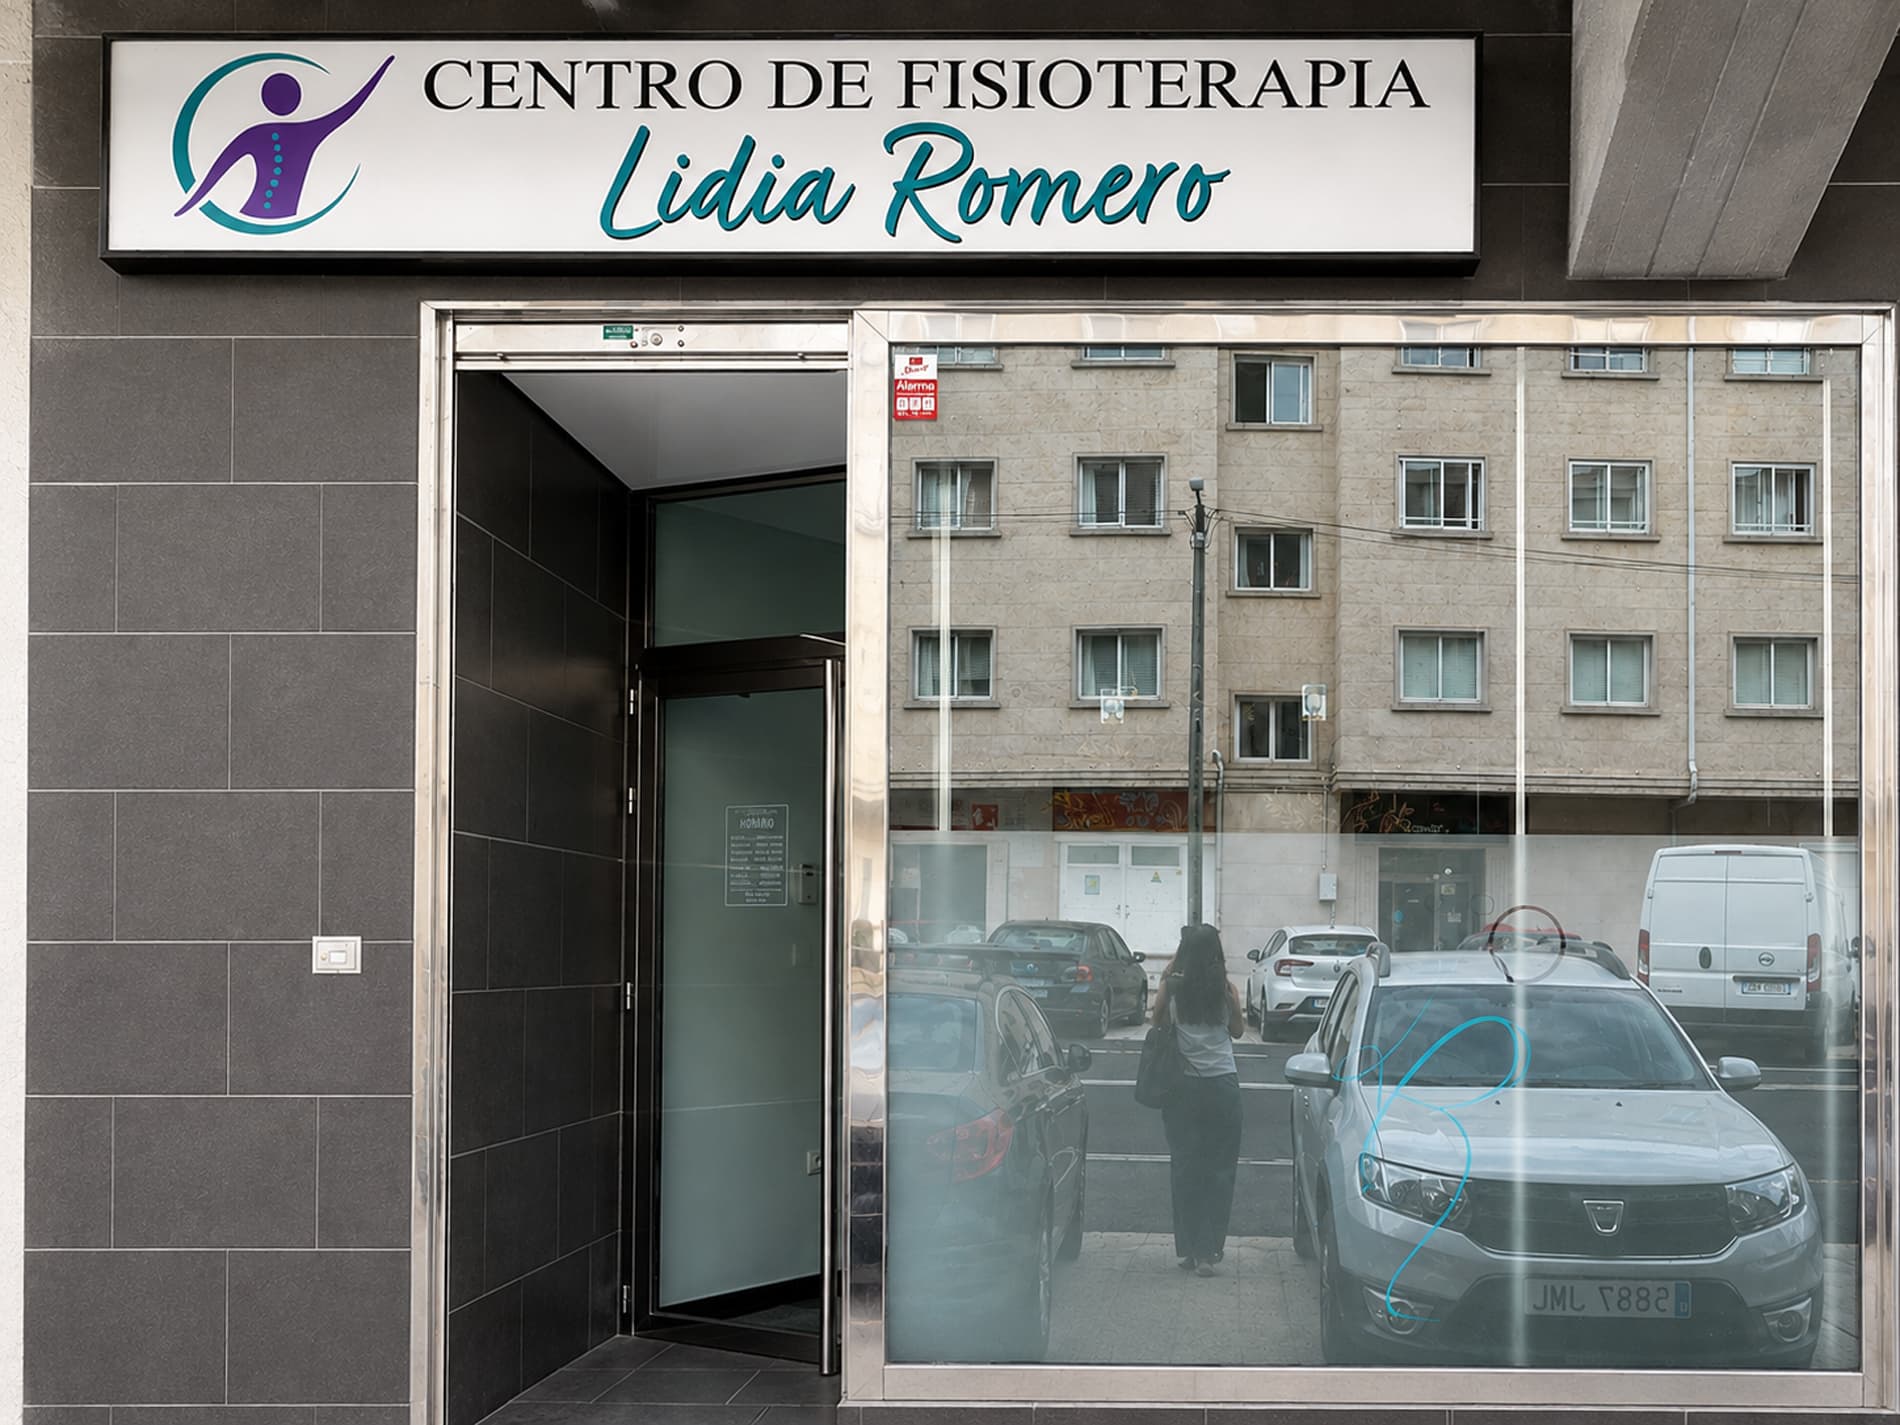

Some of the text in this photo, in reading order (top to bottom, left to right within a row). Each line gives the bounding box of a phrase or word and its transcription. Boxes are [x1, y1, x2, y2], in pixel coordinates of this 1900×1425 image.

[424, 59, 1431, 110] CENTRO DE FISIOTERAPIA
[599, 121, 1231, 244] Lidia Romero
